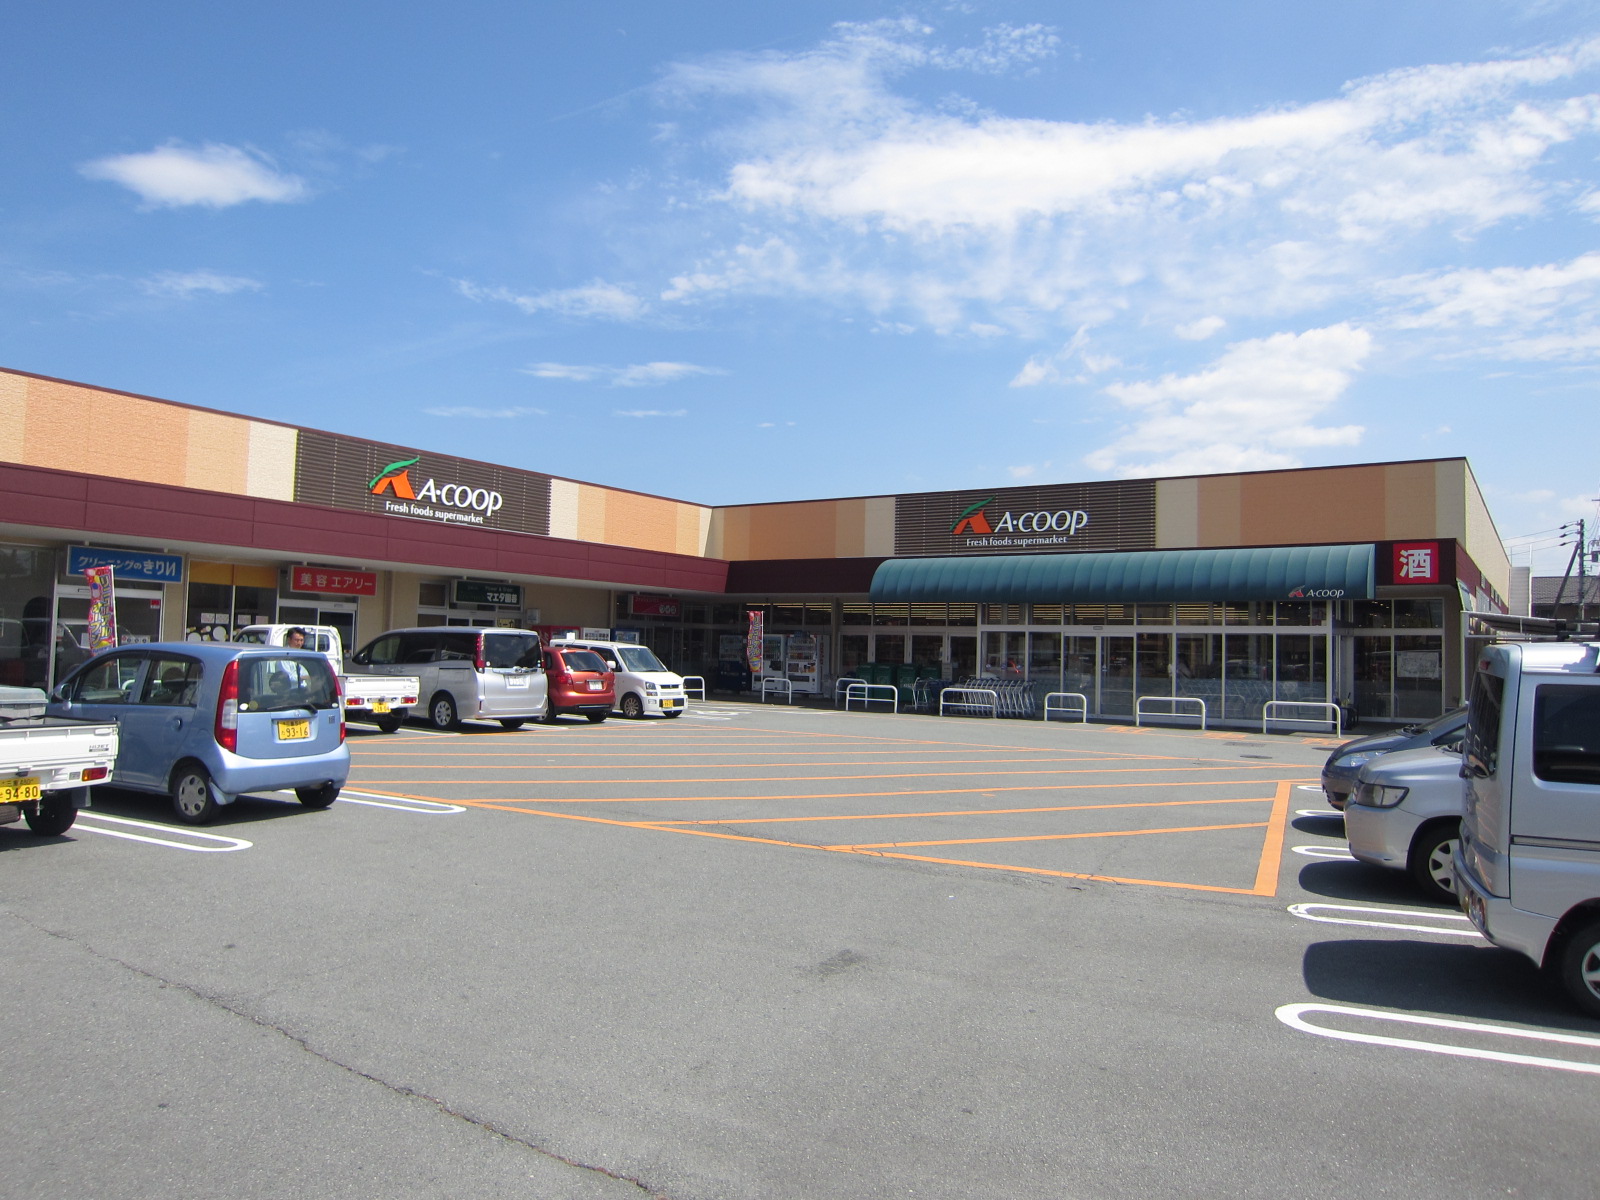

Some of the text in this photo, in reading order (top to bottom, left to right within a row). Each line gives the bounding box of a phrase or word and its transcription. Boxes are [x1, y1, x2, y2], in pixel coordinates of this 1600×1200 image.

[385, 501, 484, 524] Fresh foods supermarket
[966, 534, 1068, 548] Fresh foods supermarket
[1399, 549, 1432, 579] 酒
[285, 727, 309, 737] 93-16
[5, 786, 39, 800] 94-80
